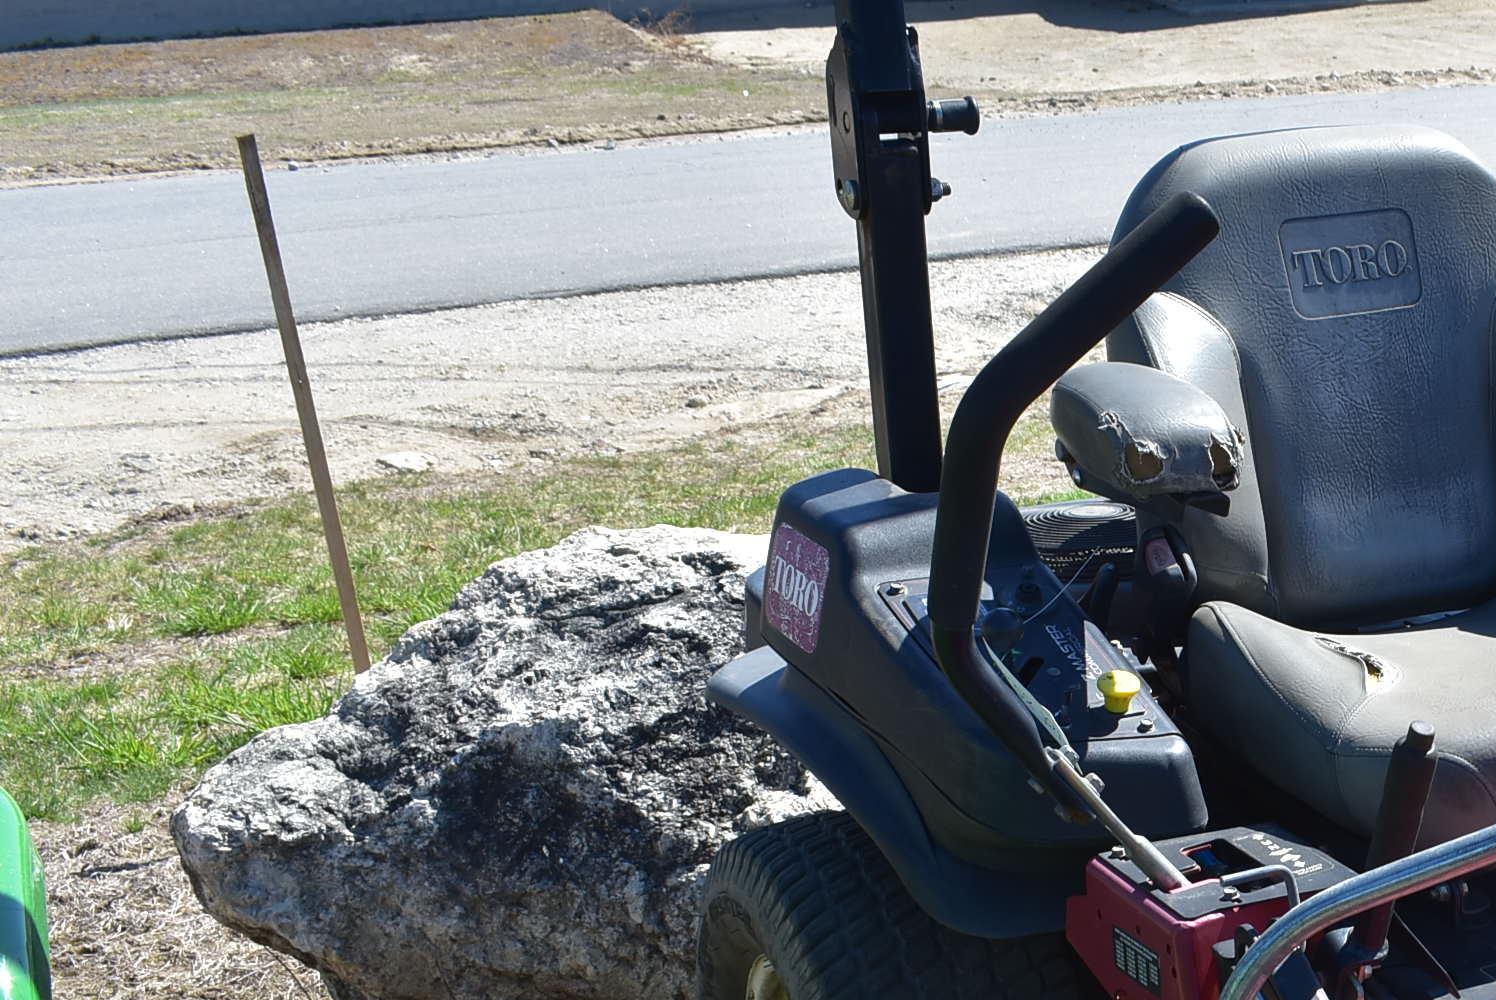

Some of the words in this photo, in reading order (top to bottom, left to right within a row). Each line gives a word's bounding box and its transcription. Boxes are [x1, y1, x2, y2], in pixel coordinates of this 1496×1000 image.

[1292, 240, 1407, 287] TORO
[774, 556, 819, 617] TORO
[1045, 624, 1090, 671] MASTER
